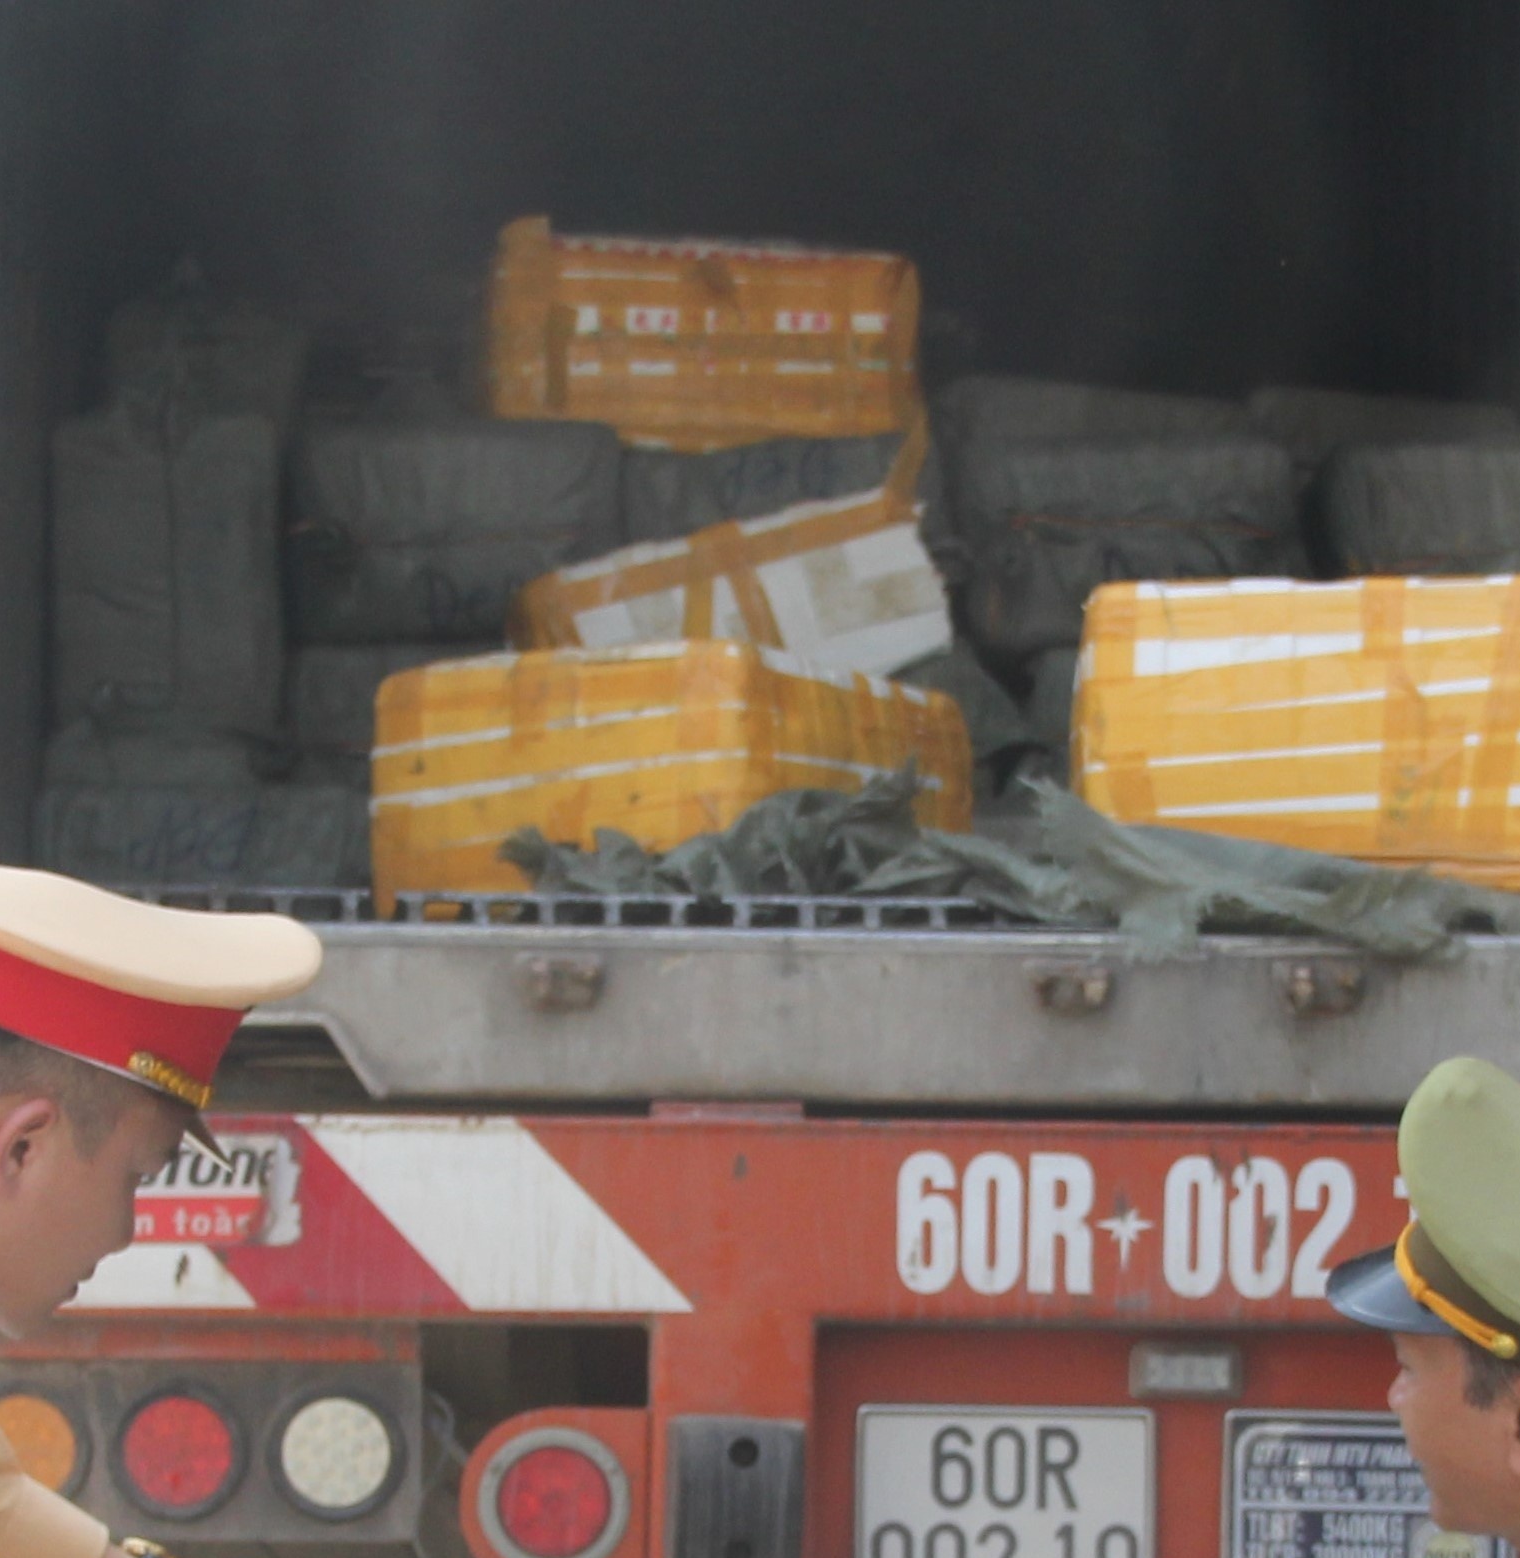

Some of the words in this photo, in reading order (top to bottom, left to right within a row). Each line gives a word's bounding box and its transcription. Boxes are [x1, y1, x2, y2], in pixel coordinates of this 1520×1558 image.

[897, 1150, 1095, 1295] 60R
[1163, 1156, 1356, 1299] 002
[930, 1425, 1081, 1511] 60R
